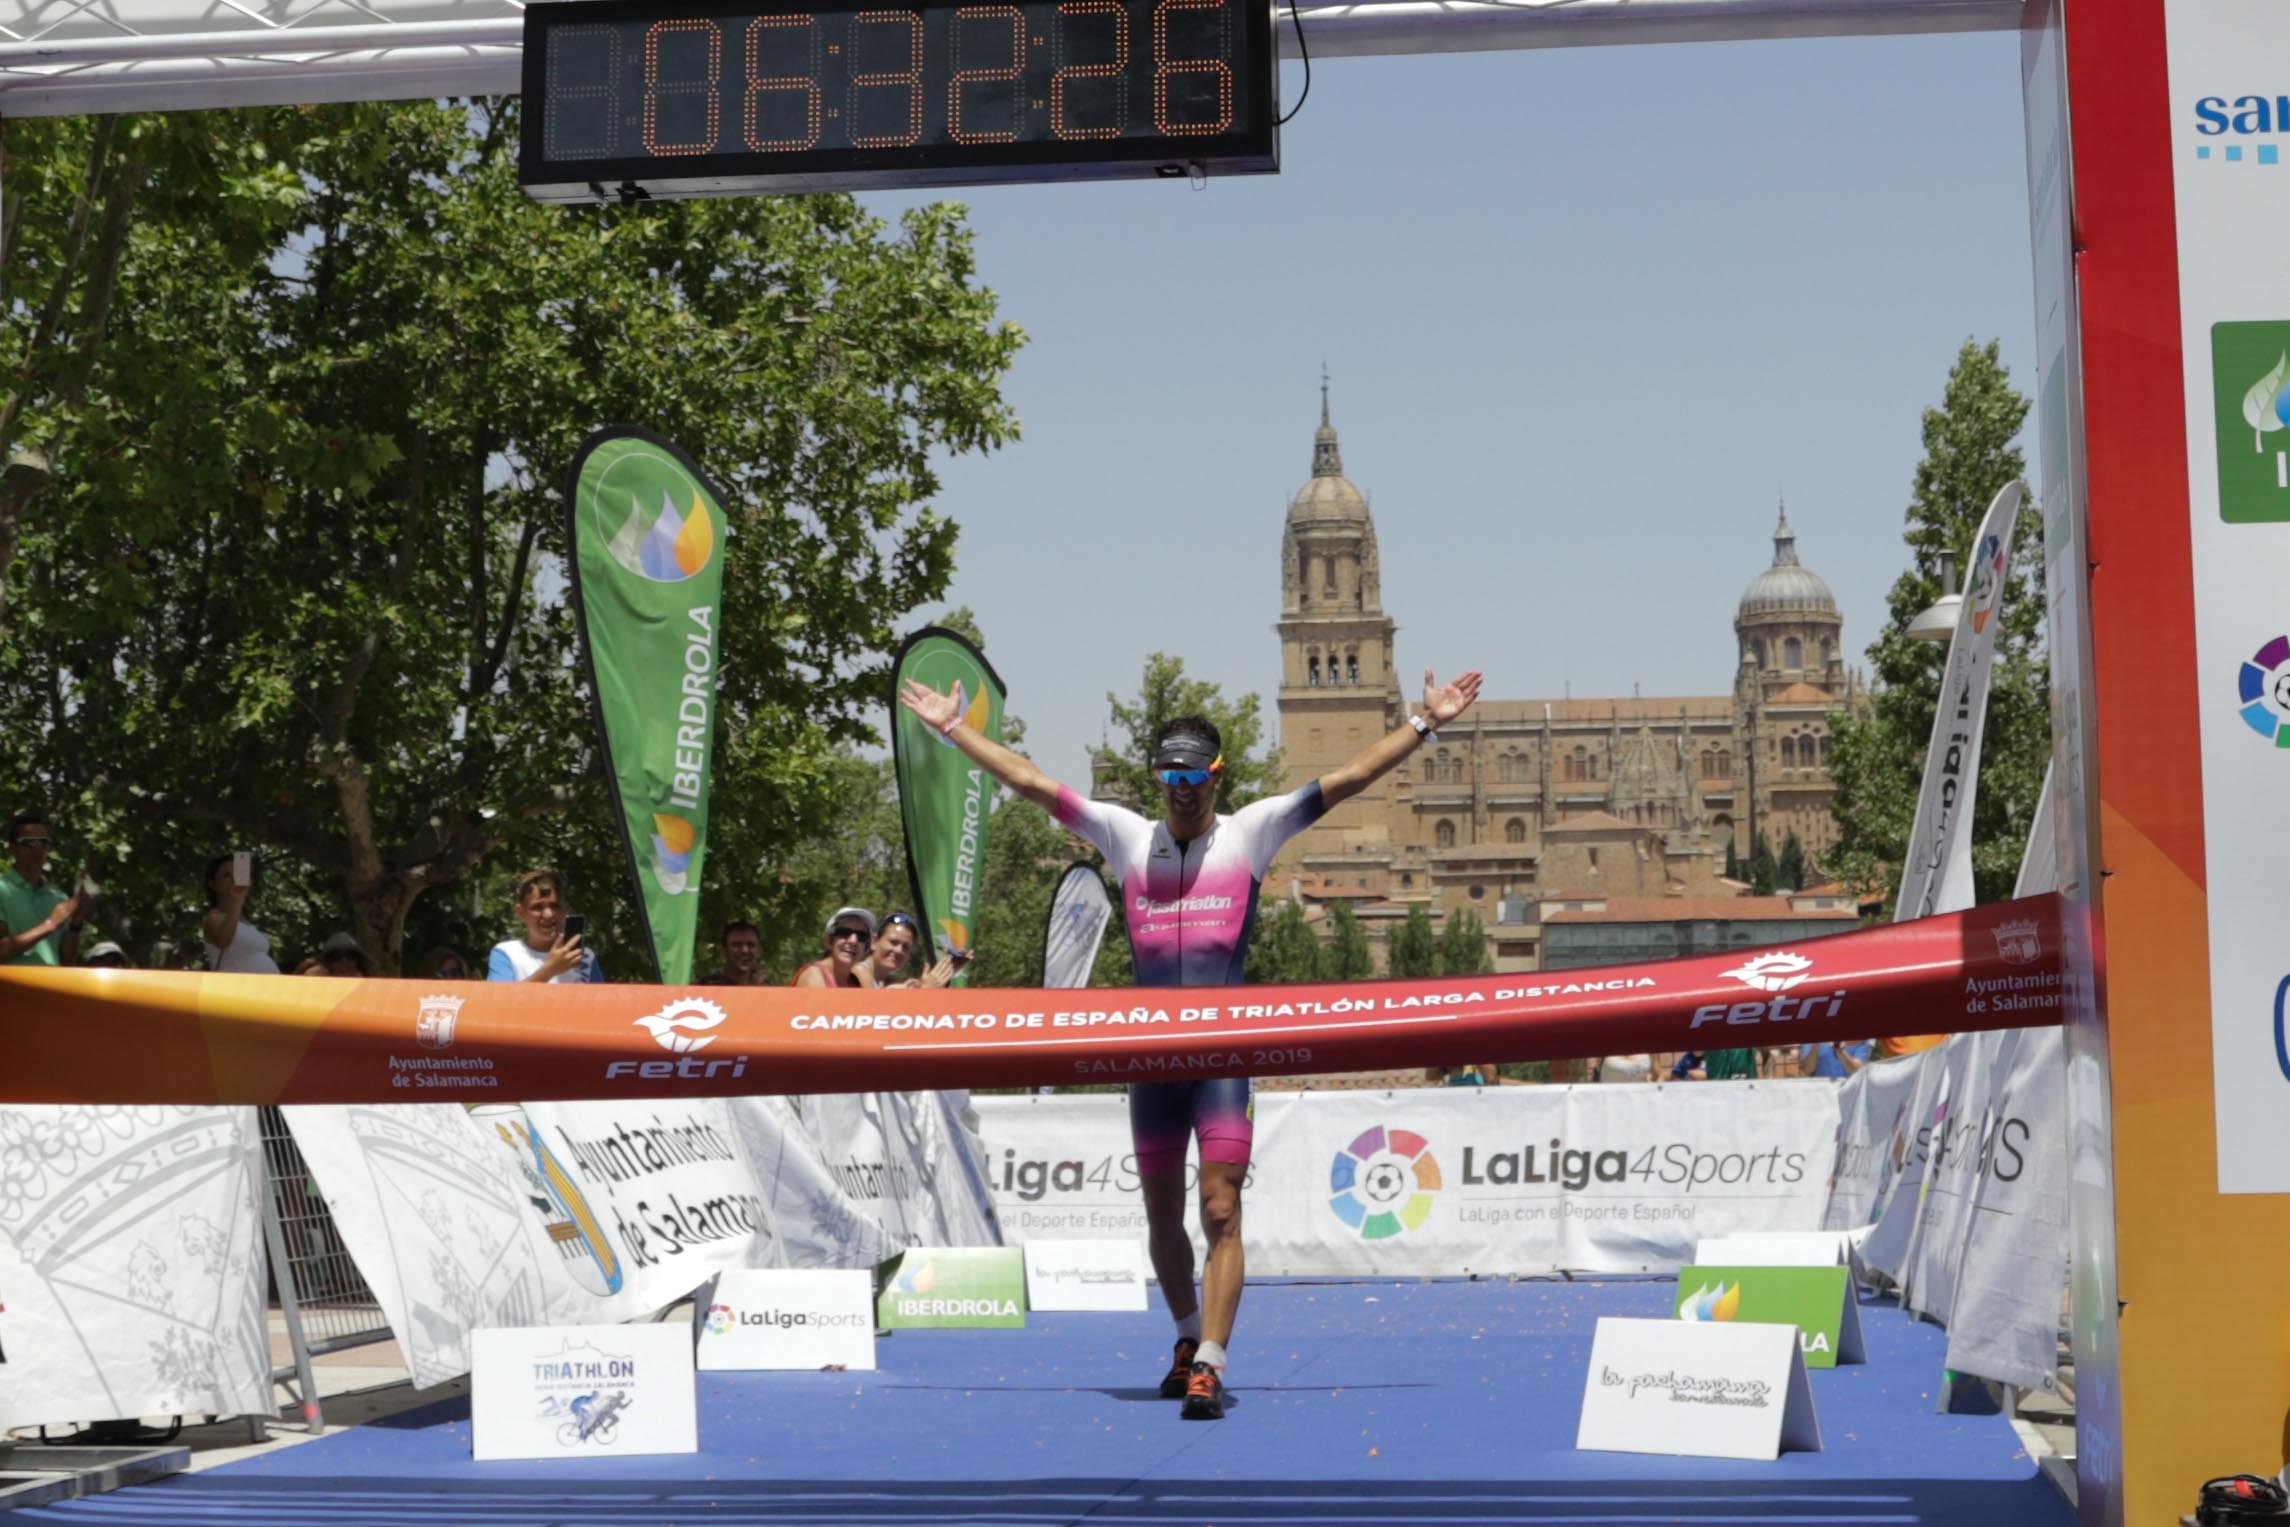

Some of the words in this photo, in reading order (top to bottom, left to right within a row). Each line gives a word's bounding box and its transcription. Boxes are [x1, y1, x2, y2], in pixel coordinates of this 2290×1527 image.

[642, 0, 1232, 156] 06:32:26
[670, 605, 712, 810] IBERDROLA
[952, 769, 981, 917] IBERDROLA
[790, 1013, 997, 1030] CAMPEONATO
[1005, 1012, 1044, 1029] DE
[1053, 1007, 1170, 1027] ESPAÑA
[1179, 1007, 1219, 1022] DE
[1228, 998, 1375, 1020] TRIATLÓN
[1384, 991, 1486, 1009] LARGA
[1495, 977, 1657, 1000] DISTANCIA
[1966, 997, 1987, 1013] de
[389, 1055, 494, 1071] Ayuntamiento
[1074, 1053, 1244, 1075] SALAMANCA
[1253, 1048, 1313, 1066] 2019
[392, 1073, 411, 1088] de
[415, 1073, 498, 1088] Salamanca
[1462, 1138, 1806, 1193] LaLiga4Sports
[1022, 1212, 1085, 1230] Deporte
[1090, 1211, 1148, 1230] Españo
[1459, 1206, 1510, 1226] LaLiga
[1514, 1208, 1545, 1221] con
[1563, 1202, 1628, 1222] Deporte
[1633, 1204, 1696, 1222] Español
[611, 1205, 660, 1268] de
[740, 1309, 866, 1331] LaLigaSports
[898, 1299, 1018, 1316] IBERDROLA
[533, 1360, 634, 1381] TRIATHLON
[1601, 1366, 1625, 1386] la
[1628, 1370, 1771, 1399] pachamama
